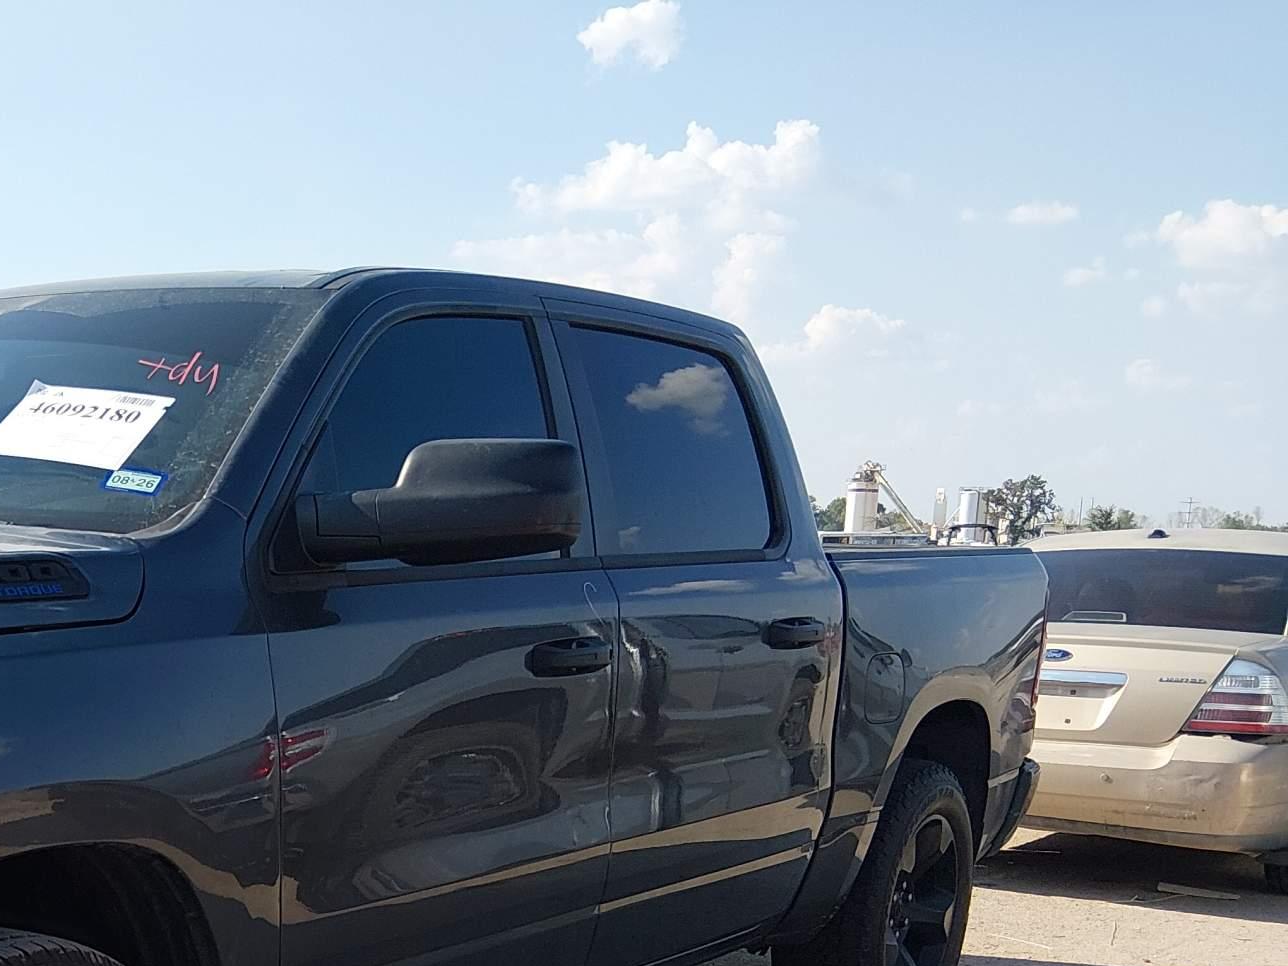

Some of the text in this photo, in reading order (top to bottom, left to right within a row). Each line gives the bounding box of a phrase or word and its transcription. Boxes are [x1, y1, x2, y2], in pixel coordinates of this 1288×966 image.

[29, 402, 142, 424] 46092180
[112, 475, 156, 489] 08 26
